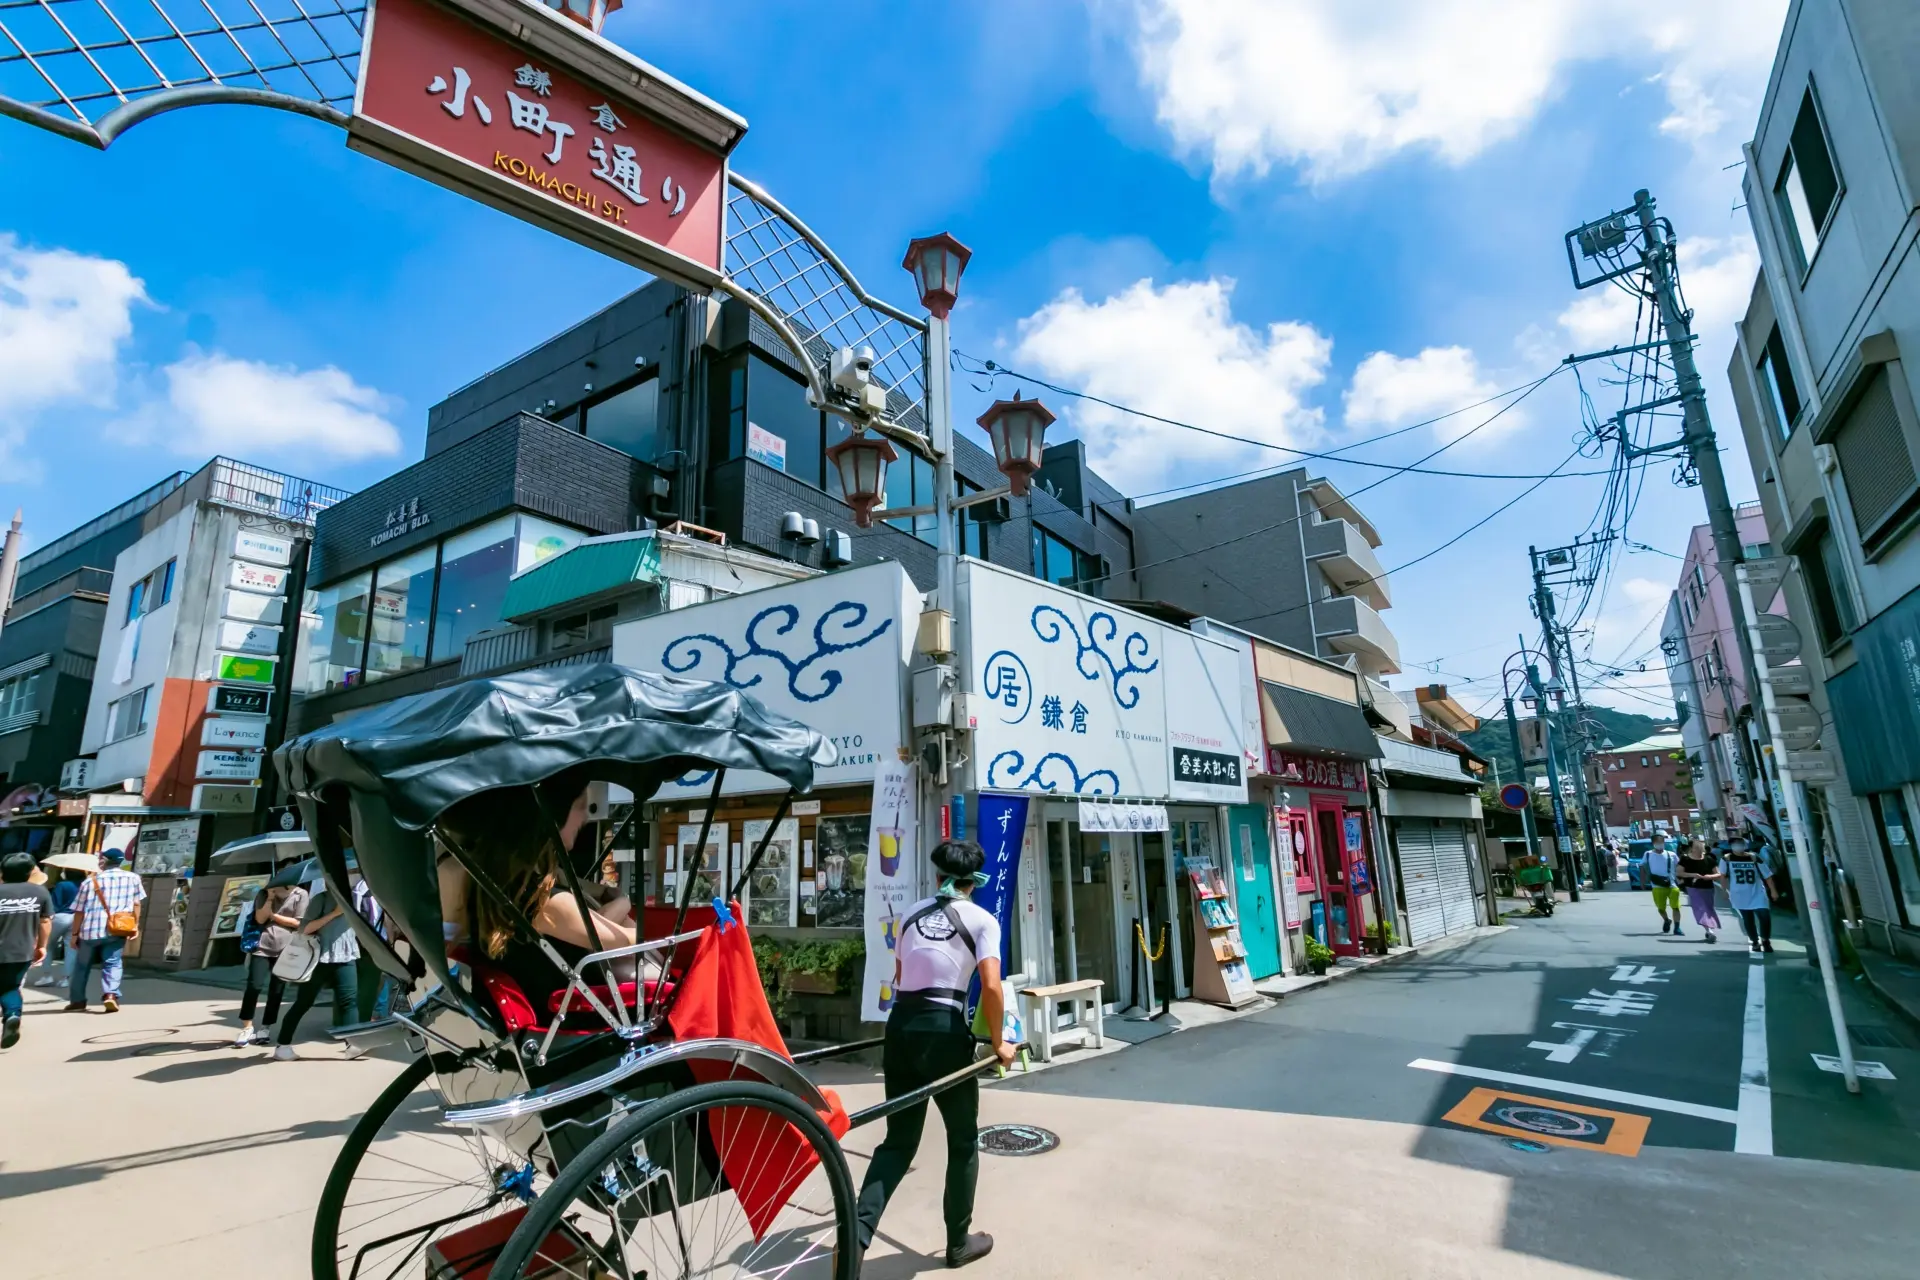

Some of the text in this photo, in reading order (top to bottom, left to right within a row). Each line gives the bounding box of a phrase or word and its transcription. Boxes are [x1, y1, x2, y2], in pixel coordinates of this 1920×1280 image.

[426, 66, 687, 217] 小町通り
[493, 150, 629, 225] KOMACHI ST.
[370, 522, 408, 548] KOMACHI
[1040, 694, 1090, 734] 鎌倉
[1734, 869, 1756, 885] 28
